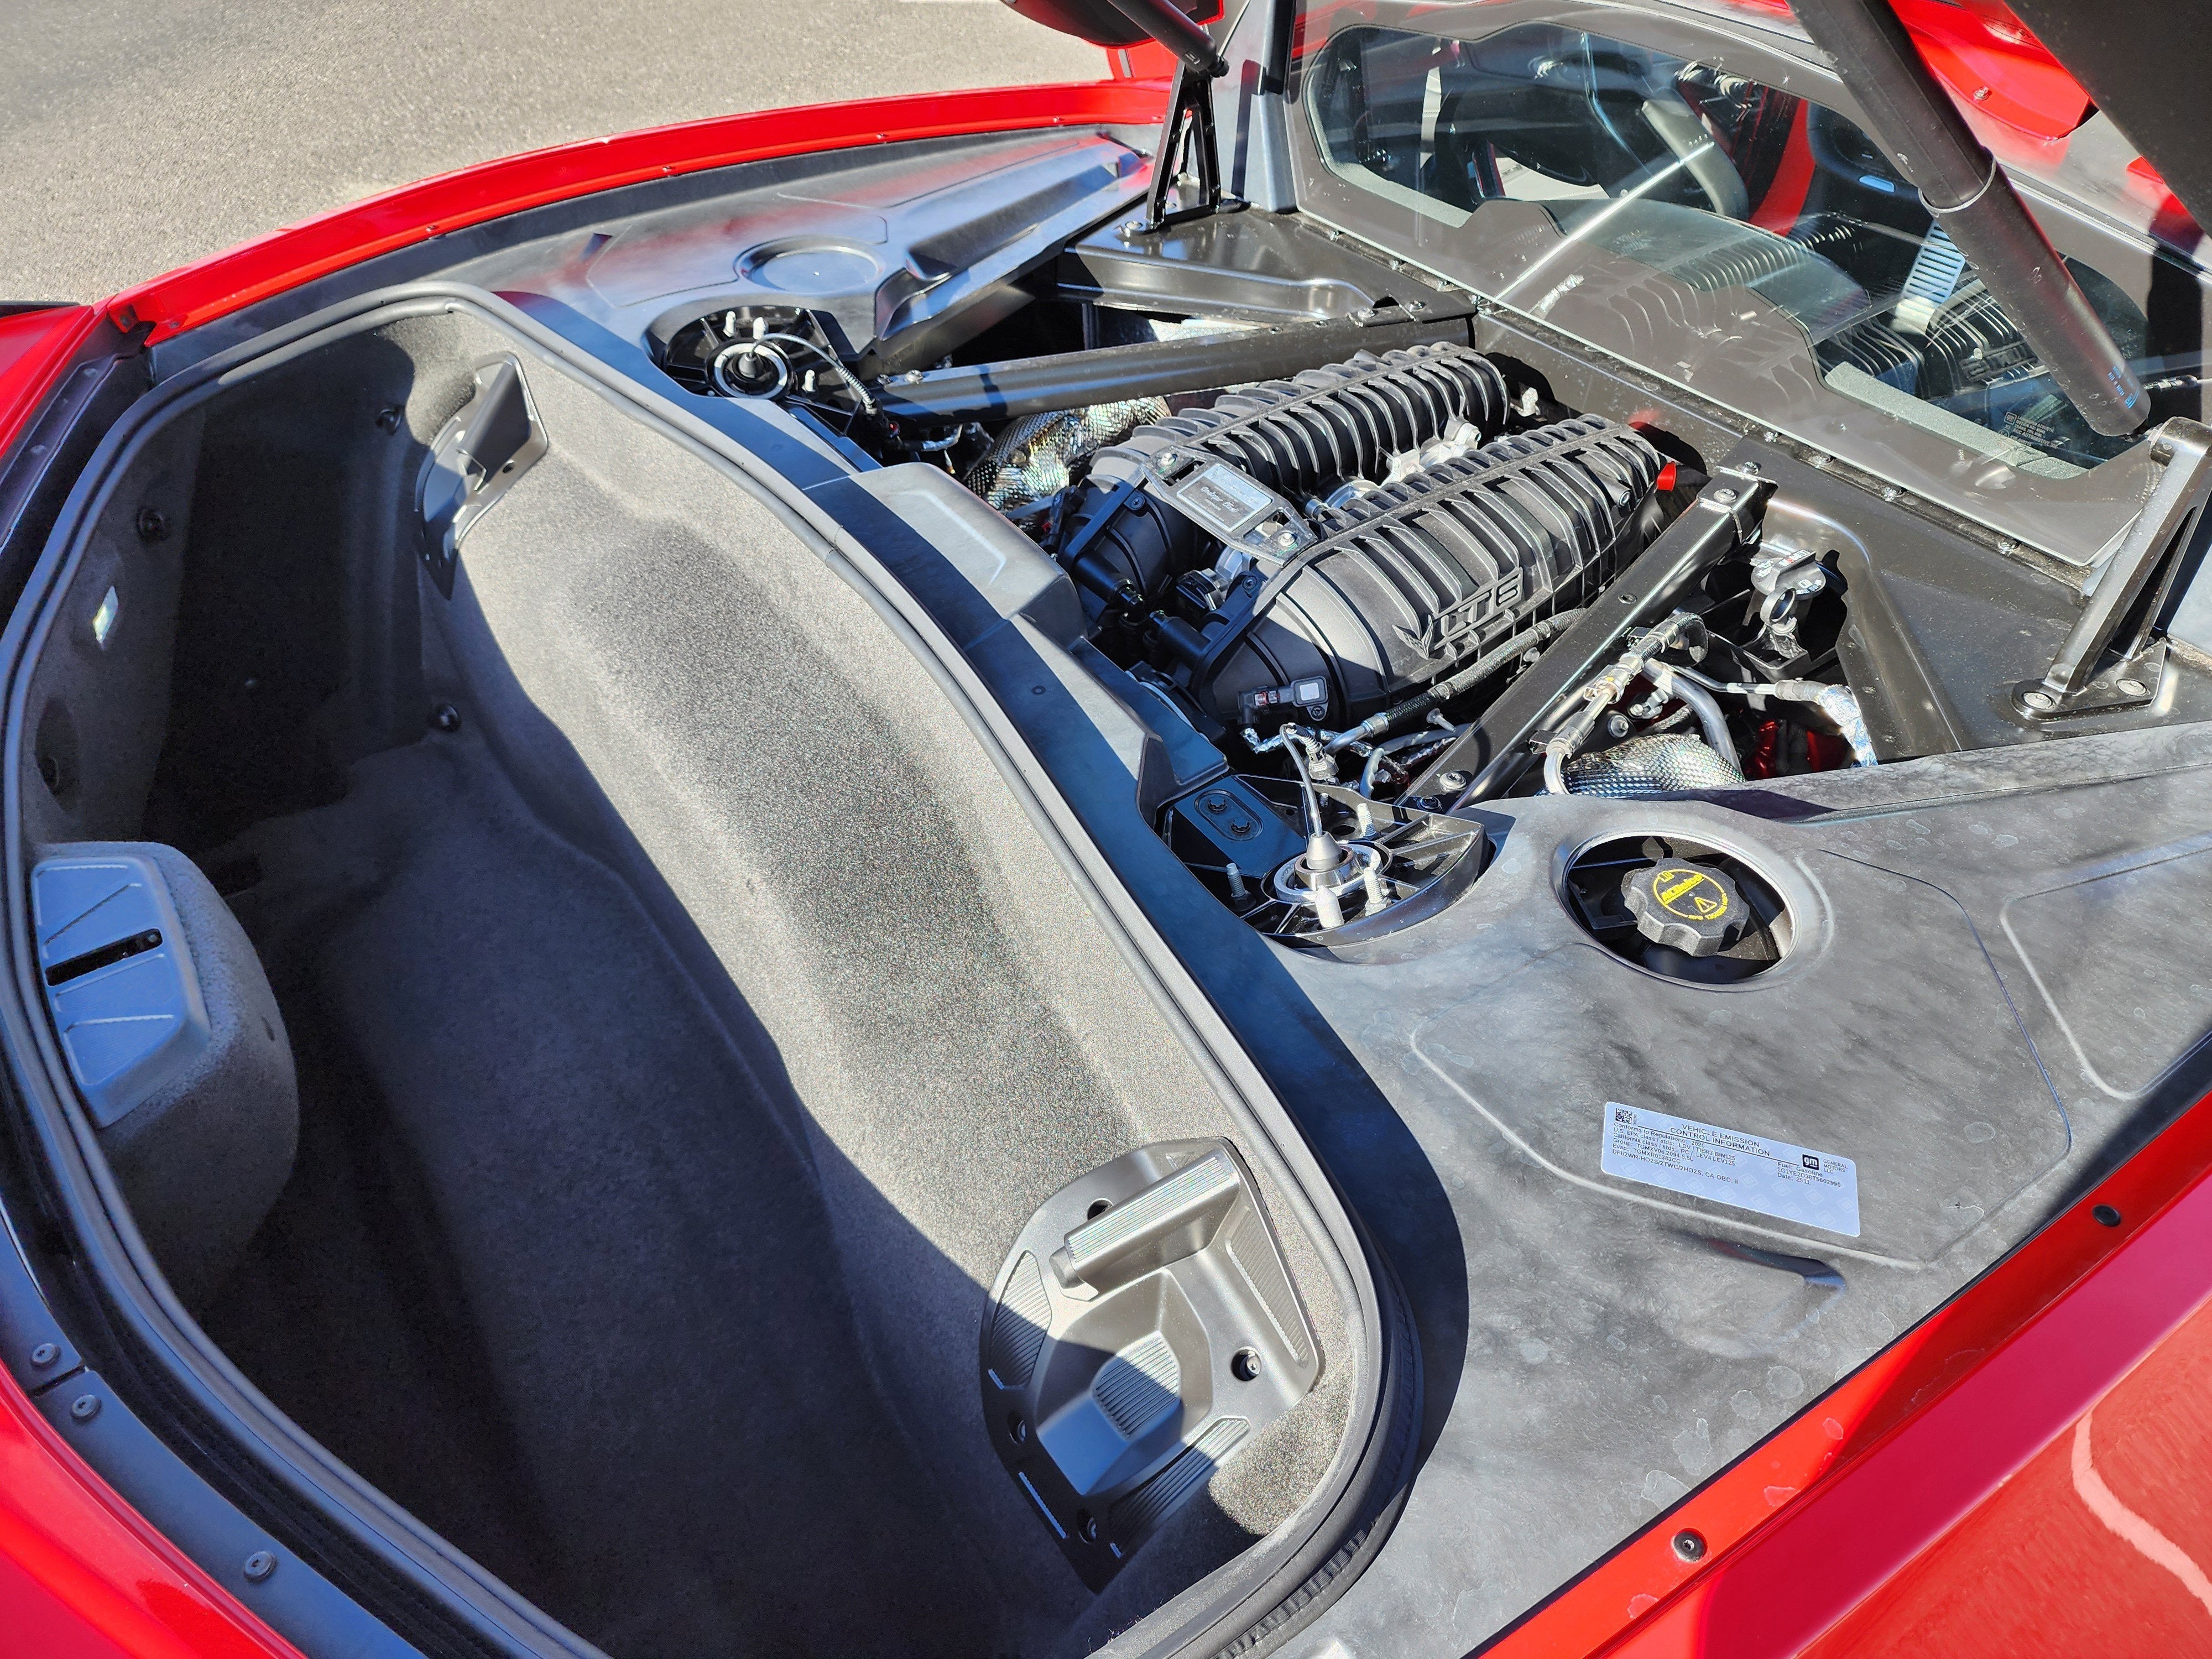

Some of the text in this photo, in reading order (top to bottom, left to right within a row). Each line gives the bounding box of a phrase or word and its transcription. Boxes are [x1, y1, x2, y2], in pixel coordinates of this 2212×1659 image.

[1441, 572, 1520, 637] LT6
[1661, 874, 1704, 901] ACDelco
[1614, 1122, 1642, 1133] Conforms
[1651, 1130, 1687, 1144] Regulations:
[1682, 1124, 1760, 1147] VEHICLE EMISSION
[1613, 1138, 1632, 1147] Group:
[1613, 1143, 1629, 1151] Evap:
[1613, 1132, 1641, 1143] California
[1696, 1152, 1712, 1160] LEV4
[1713, 1156, 1735, 1166] LEV125
[1670, 1128, 1770, 1156] CONTROL INFORMATION
[1695, 1146, 1713, 1155] TIER3
[1715, 1151, 1735, 1161] BIN125
[1777, 1161, 1823, 1177] Fuel: Gasoline
[1803, 1156, 1818, 1167] gm
[1823, 1159, 1848, 1169] GENERAL
[1823, 1164, 1846, 1173] MOTORS
[1717, 1175, 1733, 1183] OBD:
[1777, 1172, 1793, 1181] Date:
